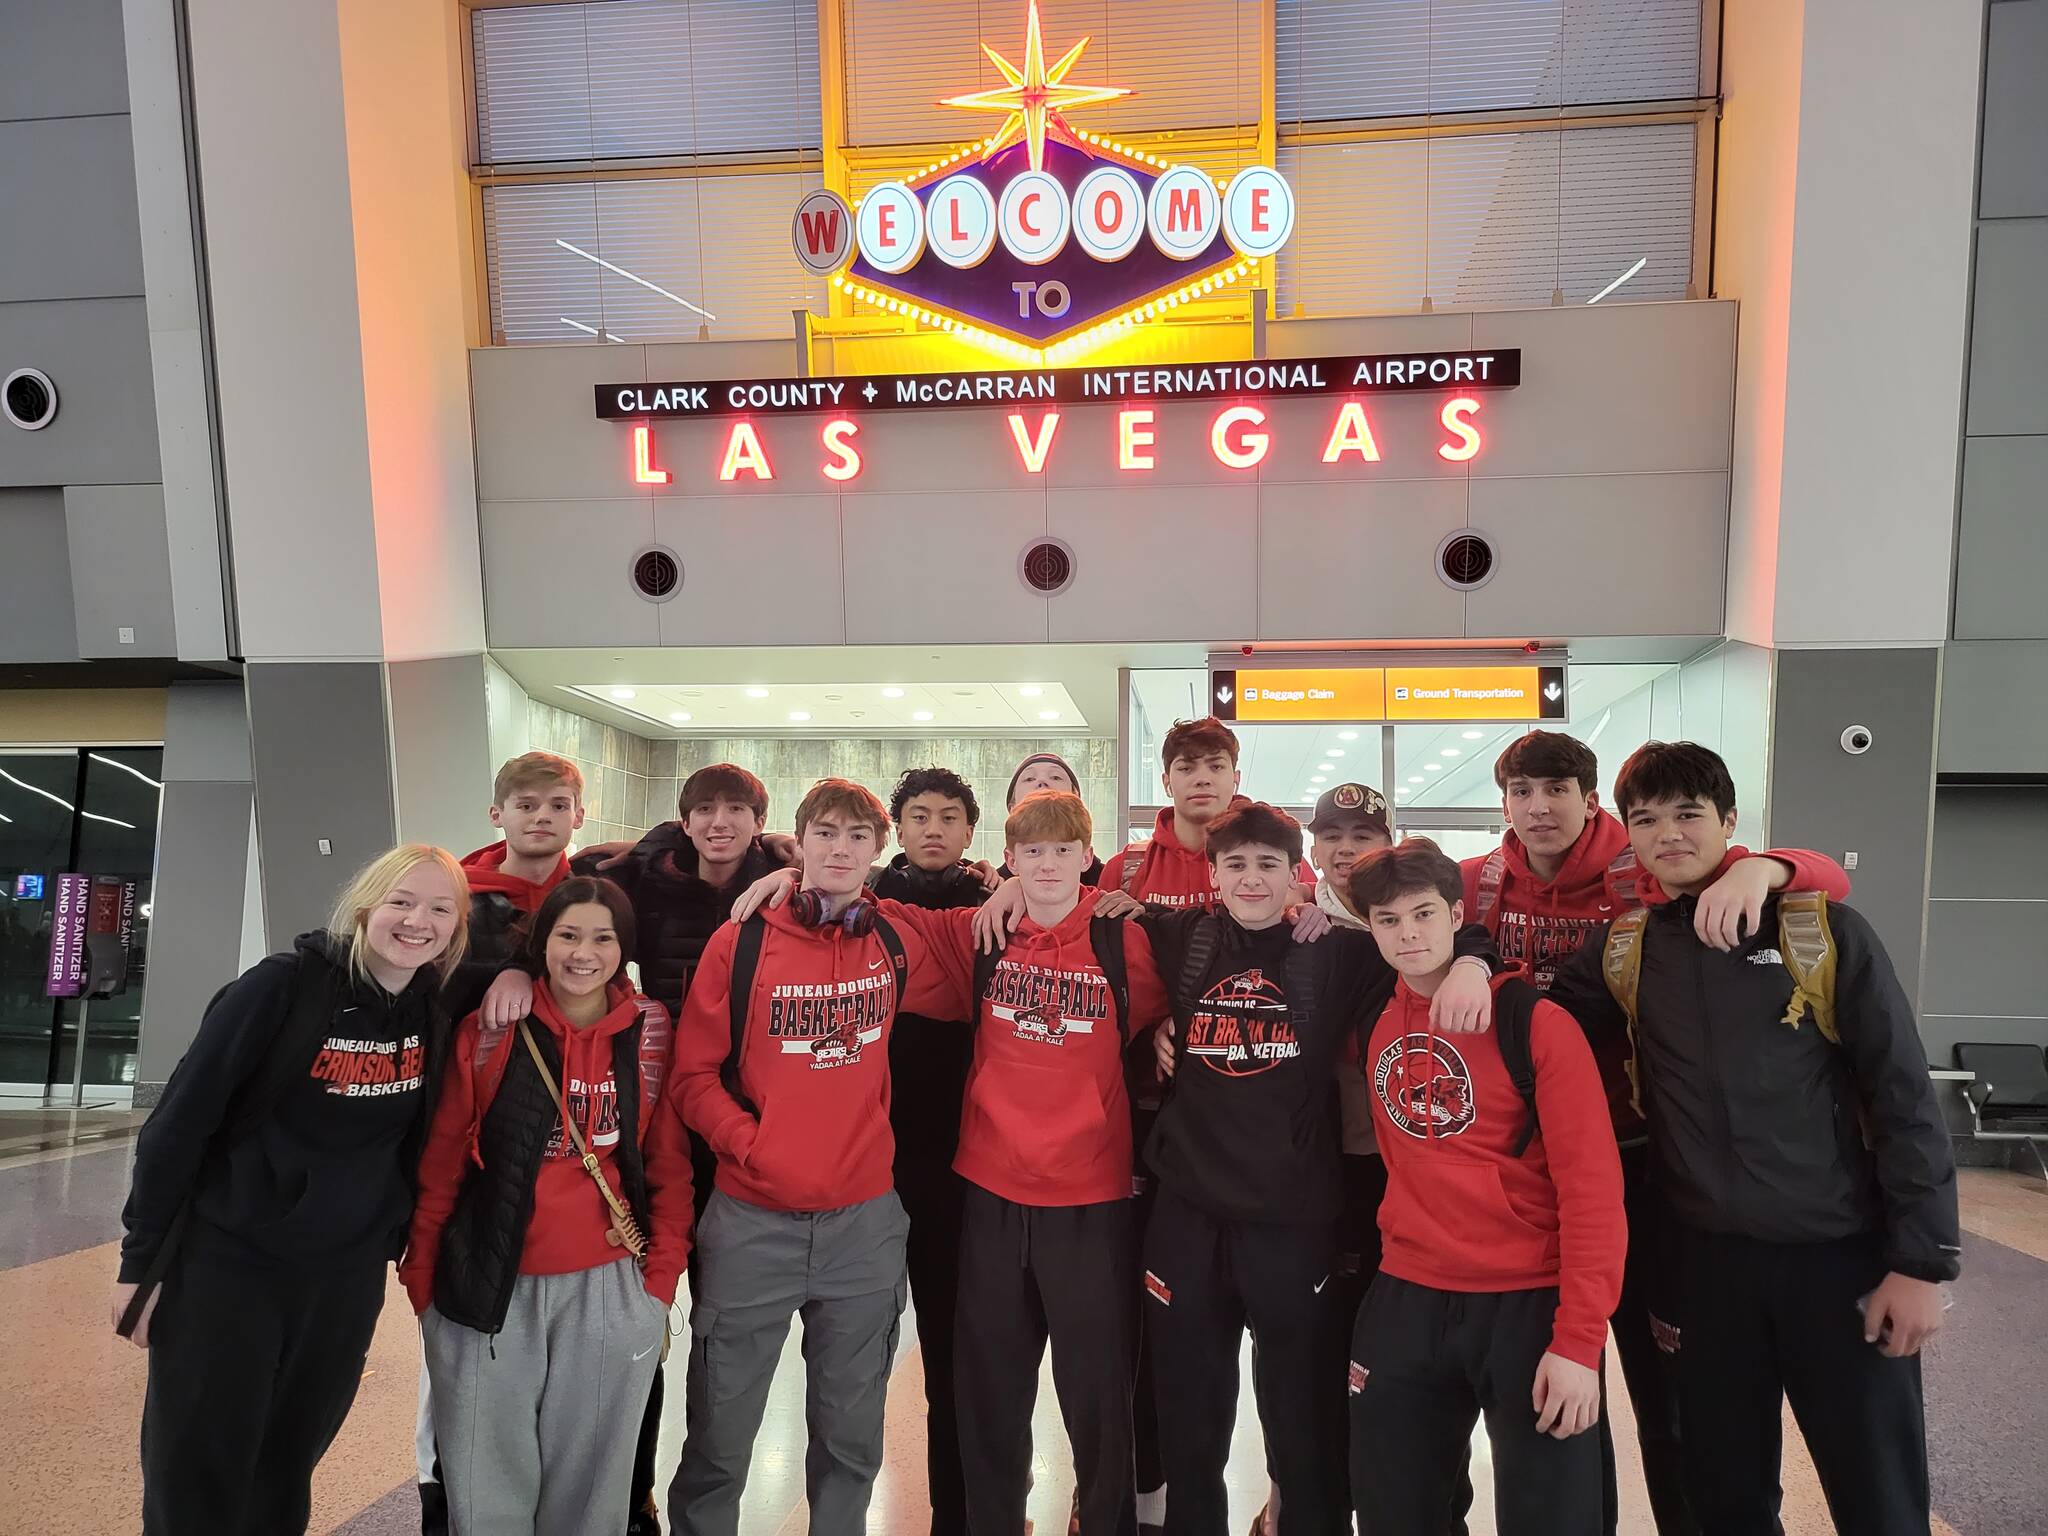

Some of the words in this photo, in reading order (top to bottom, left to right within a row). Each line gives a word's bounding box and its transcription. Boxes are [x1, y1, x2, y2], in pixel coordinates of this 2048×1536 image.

[801, 188, 1270, 255] WELCOME
[1012, 280, 1071, 319] TO
[617, 387, 709, 411] CLARK
[728, 383, 845, 408] COUNTY
[896, 375, 1056, 402] McCARRAN
[1083, 364, 1326, 396] INTERNATIONAL
[1352, 356, 1496, 385] AIRPORT
[634, 420, 862, 484] LAS
[1007, 397, 1482, 474] VEGAS
[1262, 689, 1305, 701] Baggage
[1307, 688, 1335, 700] Claim
[1413, 688, 1450, 699] Ground
[1452, 687, 1524, 700] Transportation
[59, 878, 72, 914] HAND
[74, 878, 89, 914] HAND
[123, 882, 136, 917] HAND
[52, 916, 68, 980] SANITIZER
[69, 916, 86, 981] SANITIZER
[310, 1049, 397, 1084] CRIMSON
